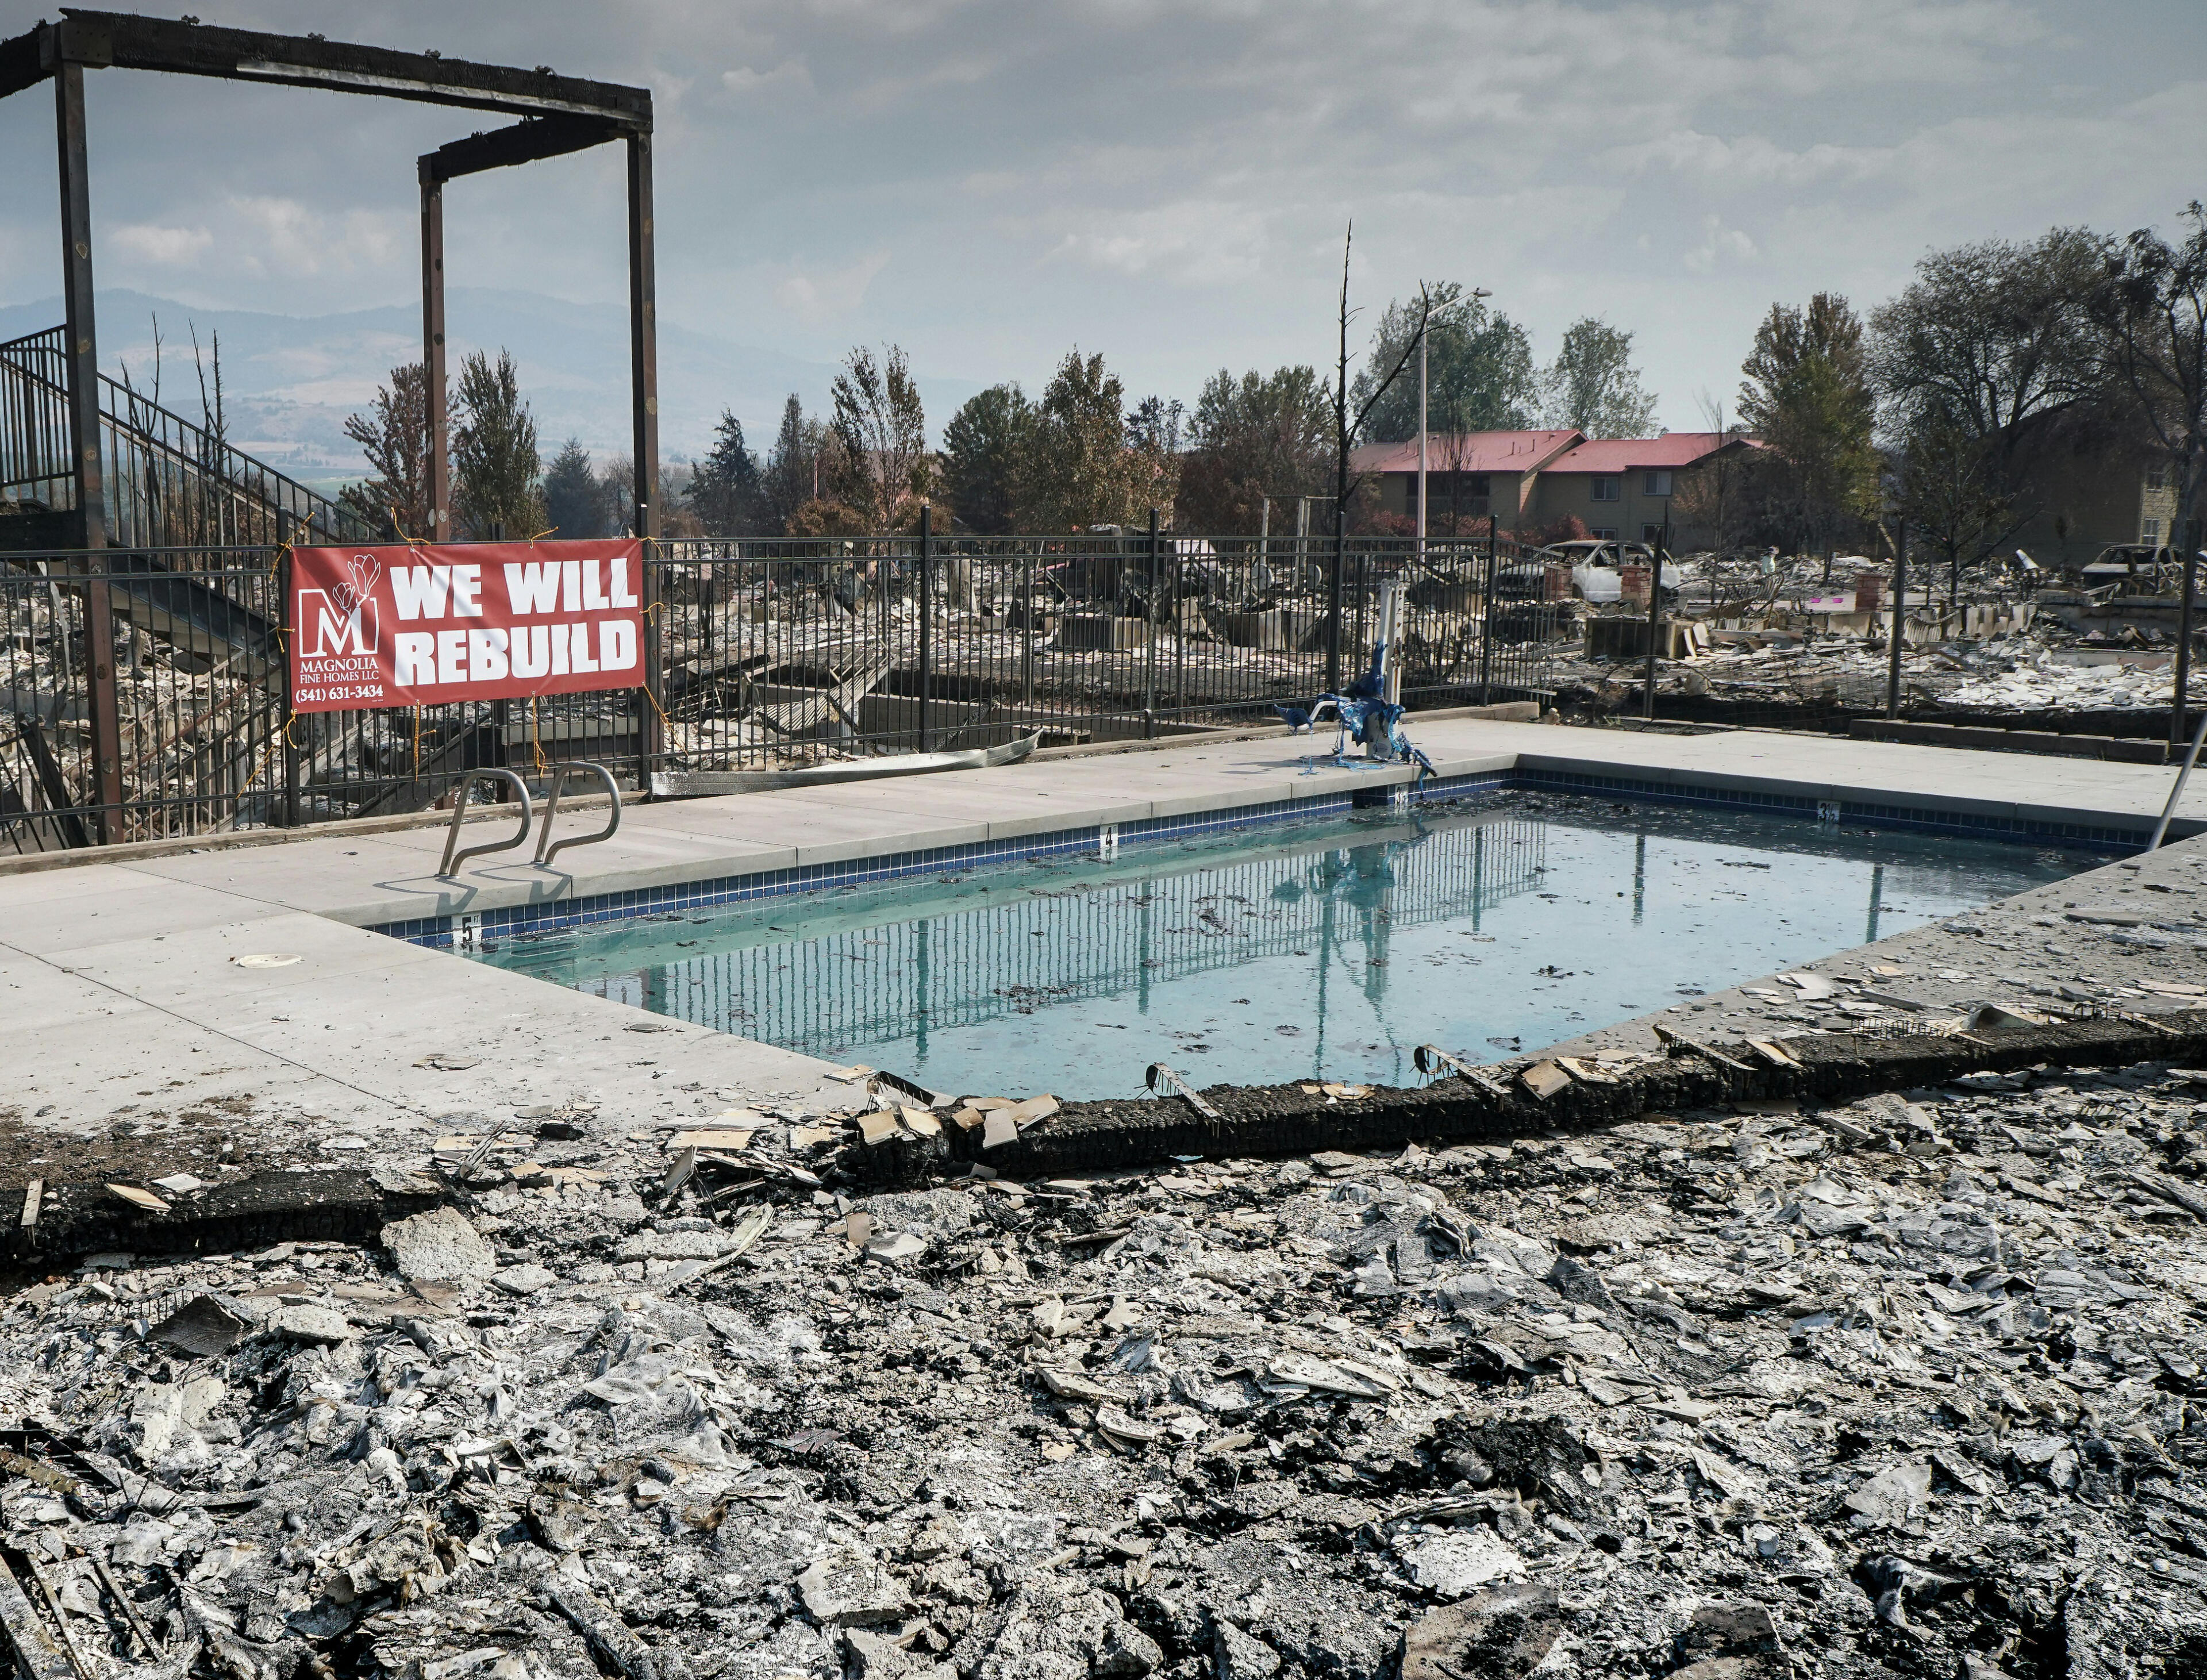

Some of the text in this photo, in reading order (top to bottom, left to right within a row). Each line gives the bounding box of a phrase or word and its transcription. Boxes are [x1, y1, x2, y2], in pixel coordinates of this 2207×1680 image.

[390, 558, 638, 620] WE WILL
[394, 620, 637, 686] REBUILD
[300, 657, 379, 673] MAGNOLIA
[300, 670, 379, 684] FINE HOMES LLC
[295, 685, 384, 703] (541) 631-3434
[1105, 826, 1113, 847] 4
[462, 916, 472, 943] 5
